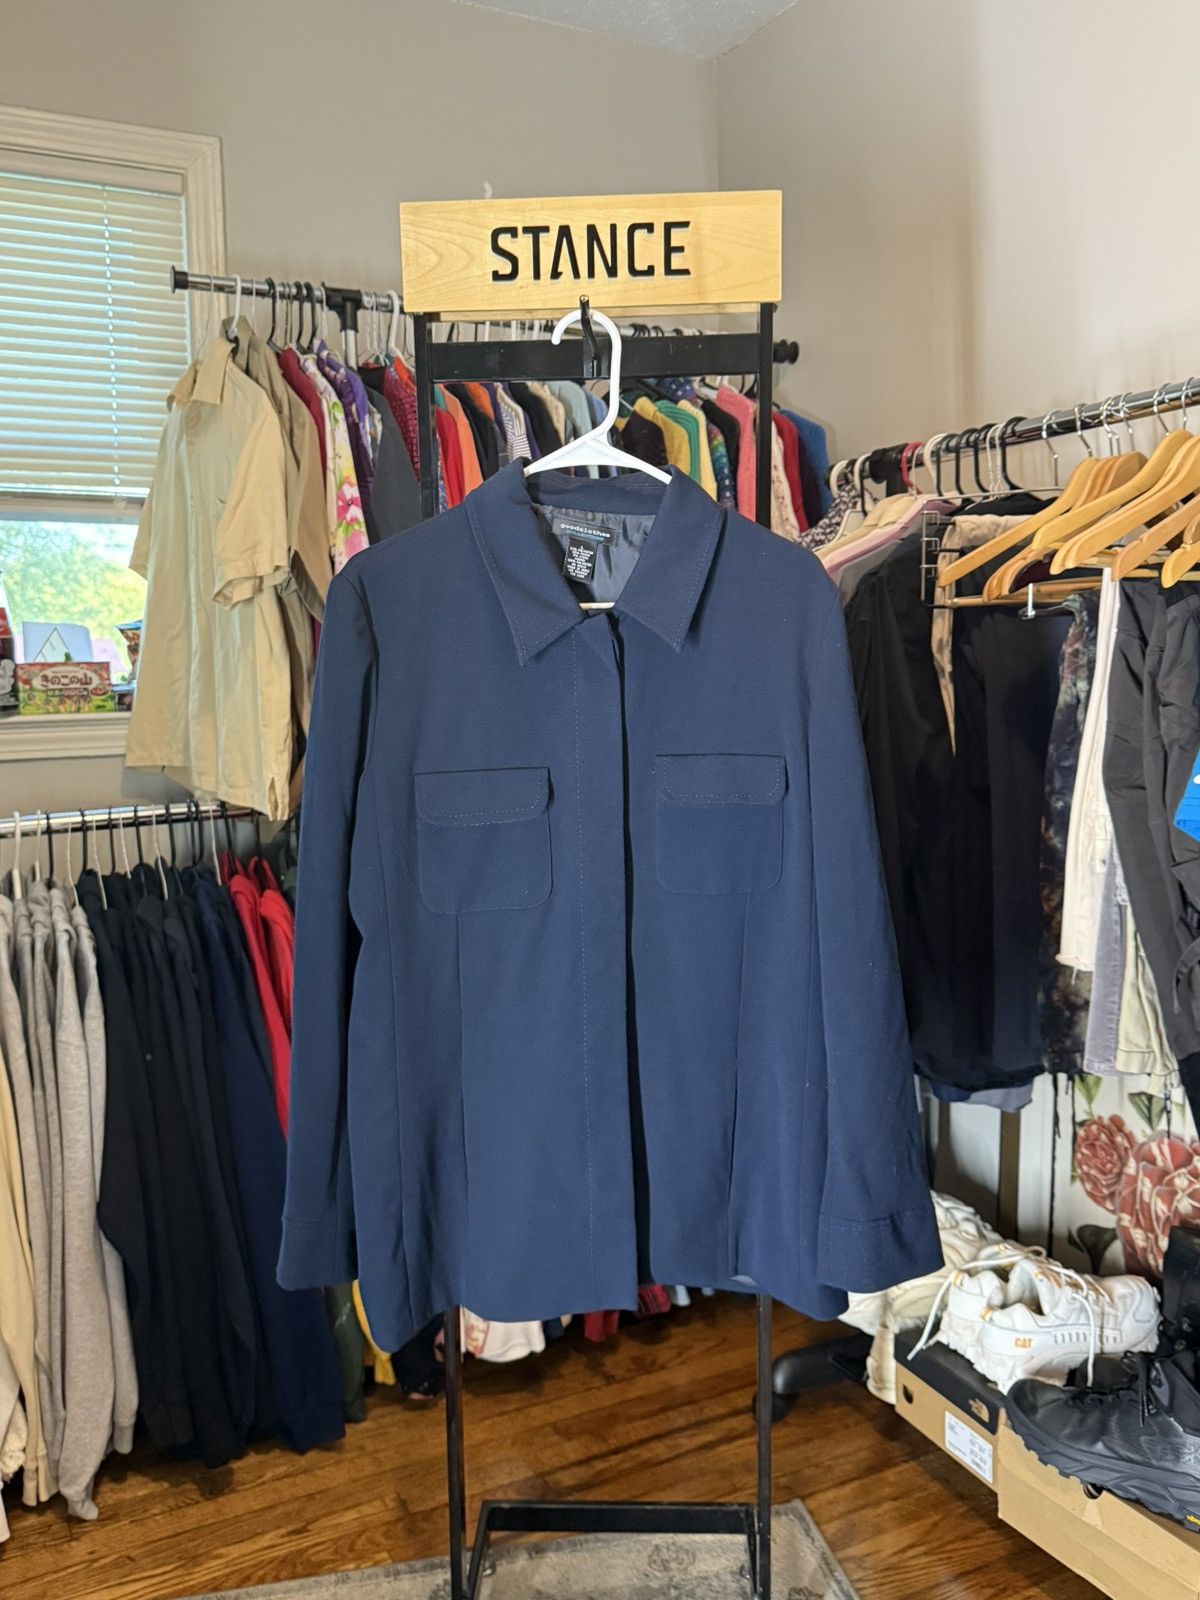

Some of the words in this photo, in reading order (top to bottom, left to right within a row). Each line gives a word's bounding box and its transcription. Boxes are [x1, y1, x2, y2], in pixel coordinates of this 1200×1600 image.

[490, 220, 691, 282] STANCE
[40, 672, 93, 688] きのこの山
[1014, 1337, 1033, 1349] CAT
